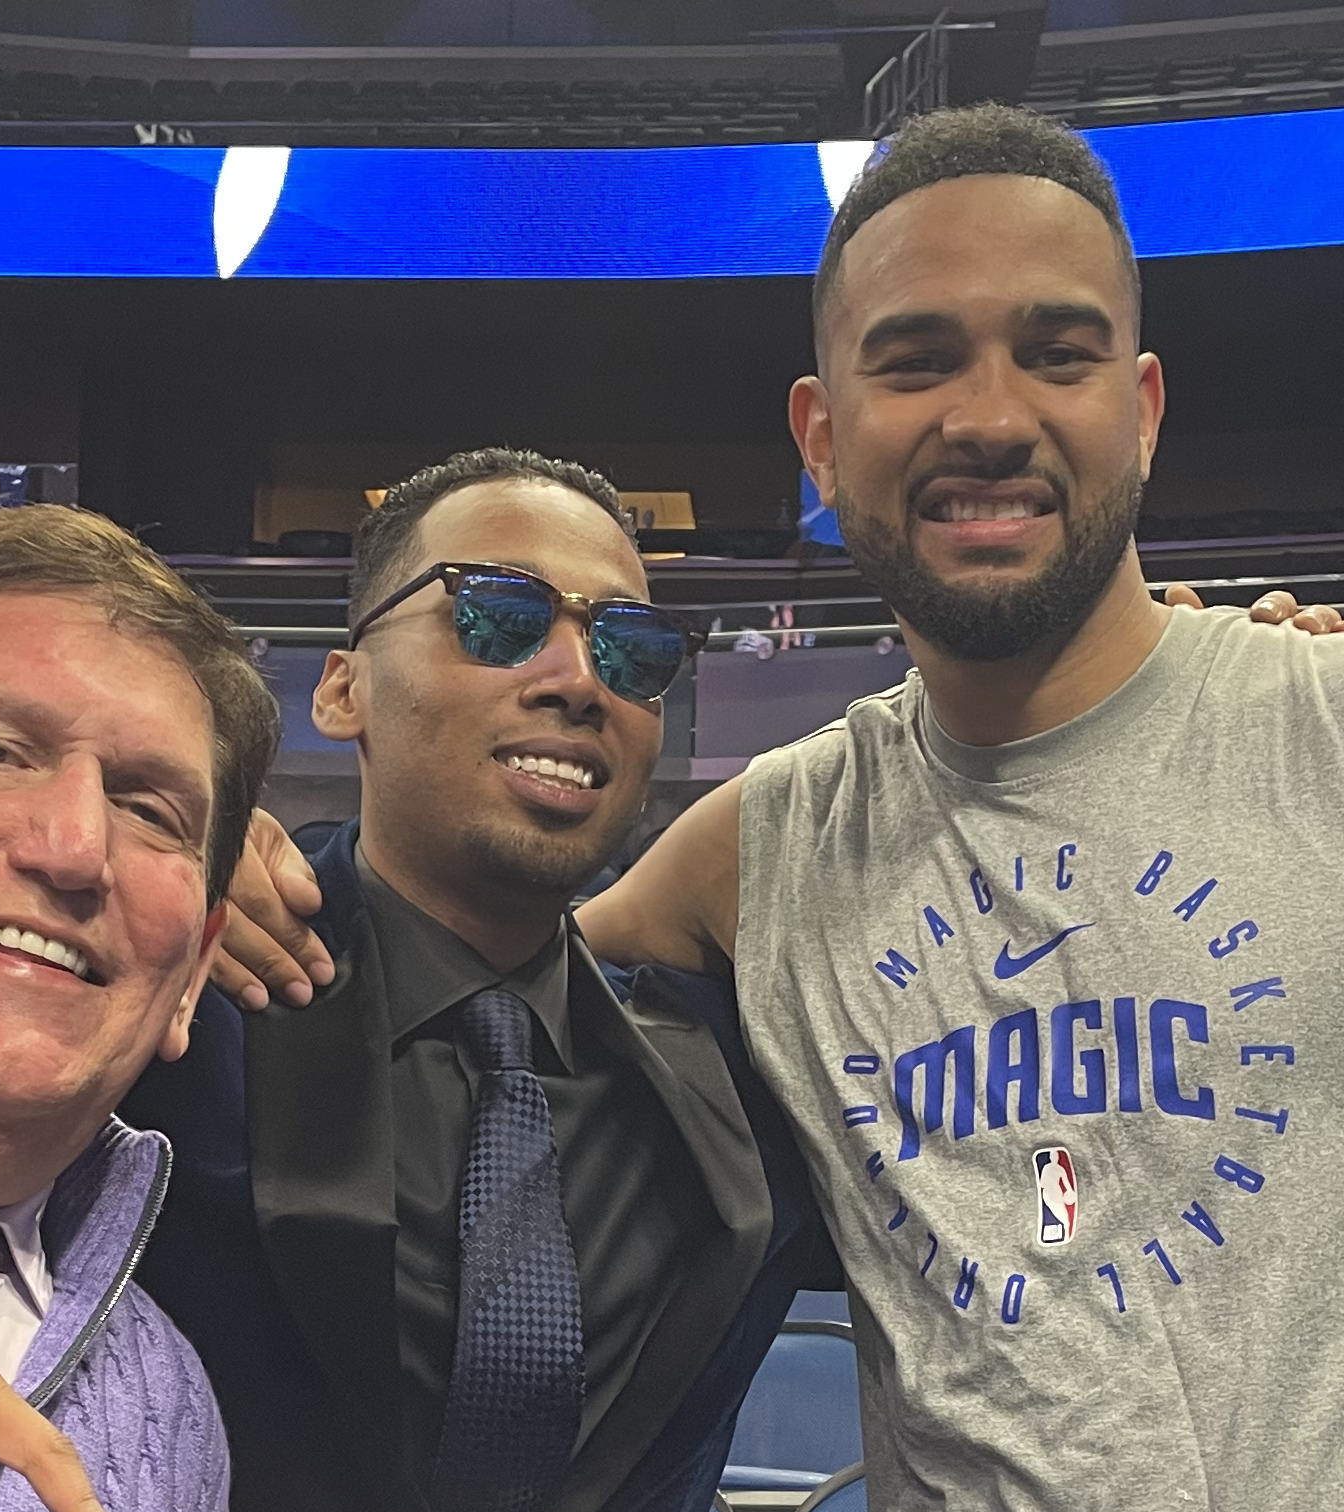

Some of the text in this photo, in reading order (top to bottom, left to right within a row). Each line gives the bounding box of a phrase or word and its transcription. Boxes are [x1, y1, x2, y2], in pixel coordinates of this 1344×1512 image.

[875, 844, 1076, 989] MAGIC
[1097, 850, 1295, 1313] BASKETBALL
[894, 997, 1216, 1161] MAGIC
